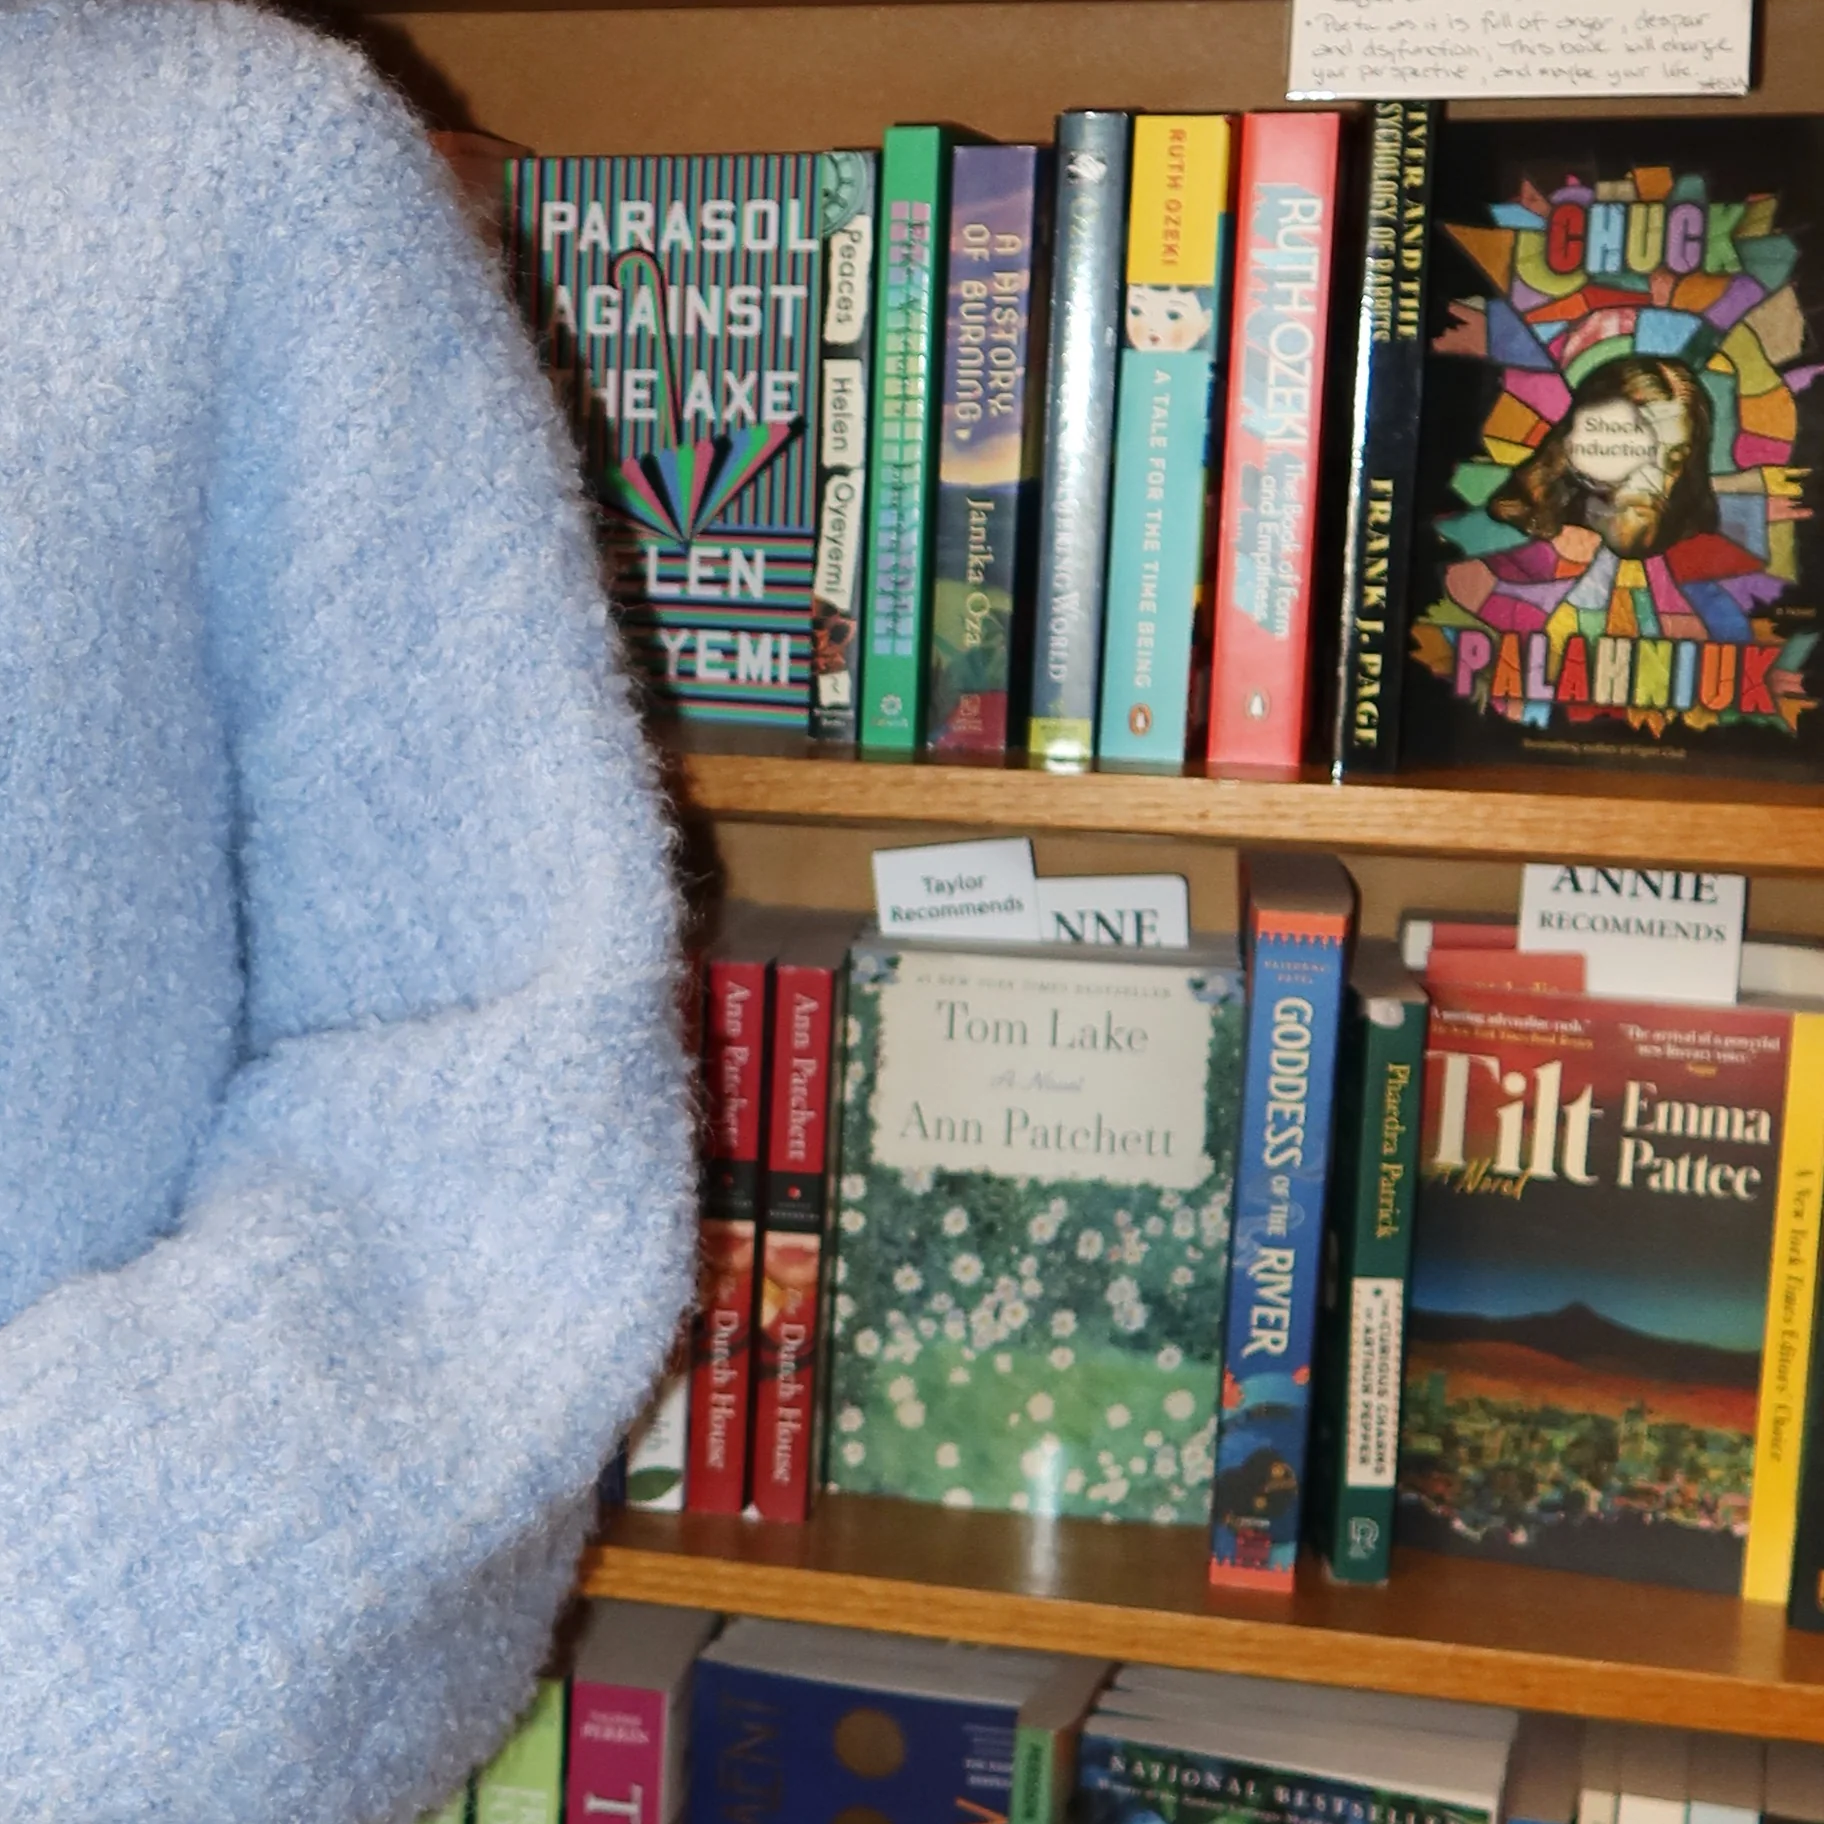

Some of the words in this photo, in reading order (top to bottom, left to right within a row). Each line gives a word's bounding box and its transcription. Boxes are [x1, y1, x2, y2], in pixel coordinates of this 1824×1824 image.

[1168, 127, 1187, 191] RUTH
[542, 198, 819, 254] PARASOL
[1160, 197, 1185, 268] OZEKI
[1277, 196, 1324, 312] RUTH
[1545, 200, 1748, 275] CHUCK
[834, 225, 864, 327] Peaces
[554, 284, 808, 338] AGAINST
[682, 368, 800, 422] AXE
[829, 377, 853, 453] Helen
[1268, 321, 1315, 449] OZEKI
[1149, 392, 1170, 450] TALE
[1584, 415, 1645, 437] Shock
[1146, 456, 1165, 502] FOR
[824, 480, 856, 596] Oyeyemi
[1144, 509, 1163, 552] THE
[1139, 558, 1159, 615] TIME
[1133, 620, 1156, 690] BEING
[1454, 629, 1781, 716] PALAHNIUK
[890, 897, 1025, 922] Recommends
[922, 874, 986, 894] Taylor
[1551, 865, 1719, 906] ANNIE
[1537, 910, 1728, 943] RECOMMENDS
[936, 1000, 1028, 1046] Tom
[1048, 1009, 1149, 1055] Lake
[1262, 995, 1315, 1169] GODDESS
[1623, 1080, 1772, 1143] Emma
[900, 1101, 983, 1144] Ann
[1004, 1107, 1174, 1157] Patchett
[1426, 1050, 1604, 1186] Tilt
[1616, 1136, 1762, 1200] Pattee
[1239, 1246, 1298, 1361] RIVER
